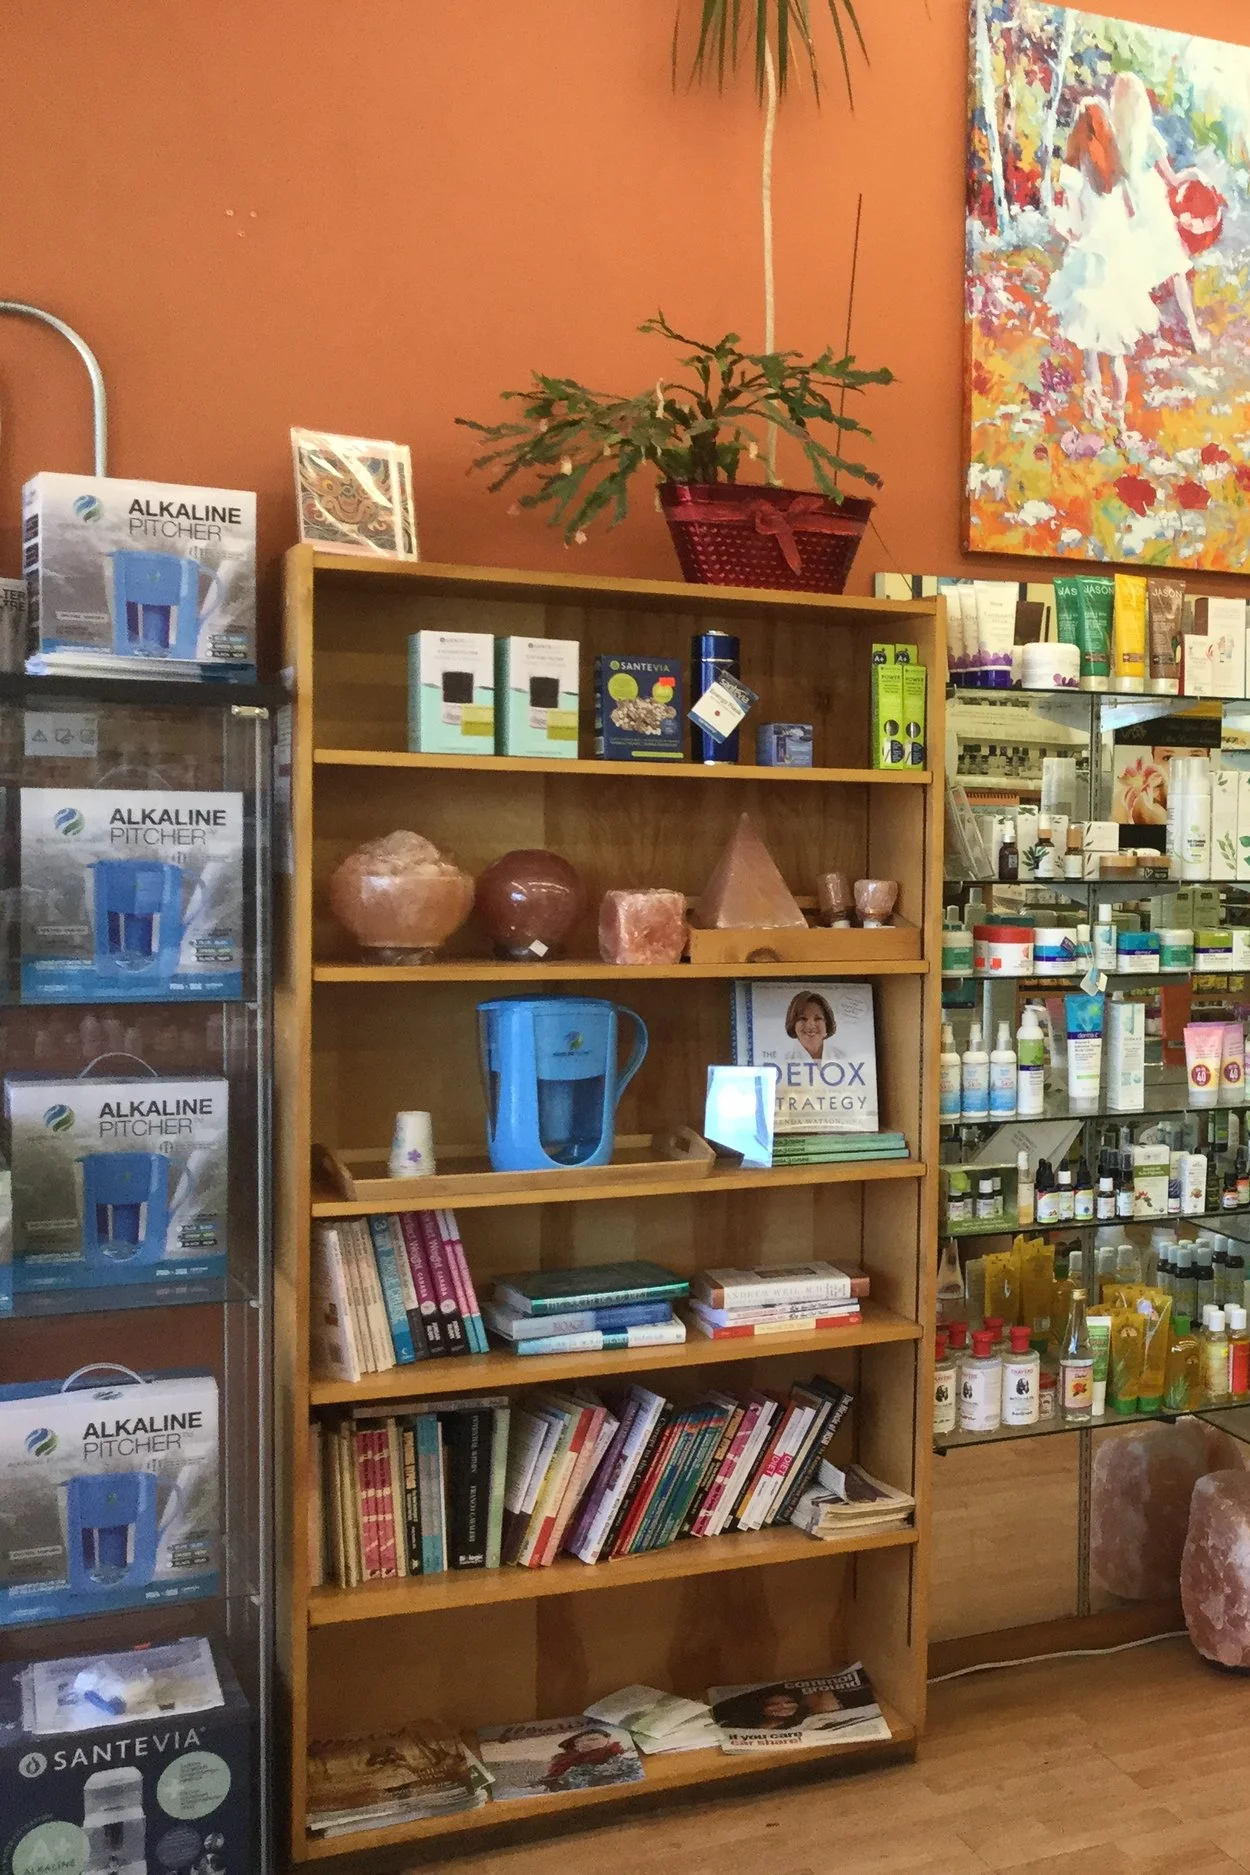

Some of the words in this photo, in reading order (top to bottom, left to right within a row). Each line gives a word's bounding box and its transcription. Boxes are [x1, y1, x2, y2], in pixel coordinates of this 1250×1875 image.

[129, 499, 242, 524] ALKALINE
[129, 518, 222, 541] PITCHER
[1058, 587, 1077, 596] JAS
[1084, 585, 1114, 595] JASON
[1152, 589, 1183, 598] JASON
[621, 662, 670, 672] SANTEVIA
[110, 808, 227, 826] ALKALINE
[111, 827, 206, 845] PITCHER
[763, 1062, 866, 1086] DETOX
[1197, 1070, 1206, 1082] 40
[1229, 1069, 1239, 1081] 40
[100, 1098, 213, 1119] ALKALINE
[777, 1096, 867, 1110] TRATEGY
[100, 1118, 193, 1137] PITCHER
[414, 1272, 430, 1298] CANADA
[434, 1270, 449, 1297] CANADA
[841, 1393, 854, 1407] The
[831, 1403, 849, 1426] Miracle
[83, 1411, 203, 1440] ALKALINE
[827, 1423, 838, 1433] of
[84, 1433, 182, 1460] PITCHER
[820, 1429, 835, 1447] MSM
[767, 1455, 780, 1476] DIET
[780, 1455, 793, 1476] DIET
[626, 1472, 643, 1496] Core
[459, 1554, 484, 1562] Bilogic
[802, 1671, 861, 1695] ground
[742, 1733, 767, 1742] you
[54, 1728, 201, 1771] SANTEVIA
